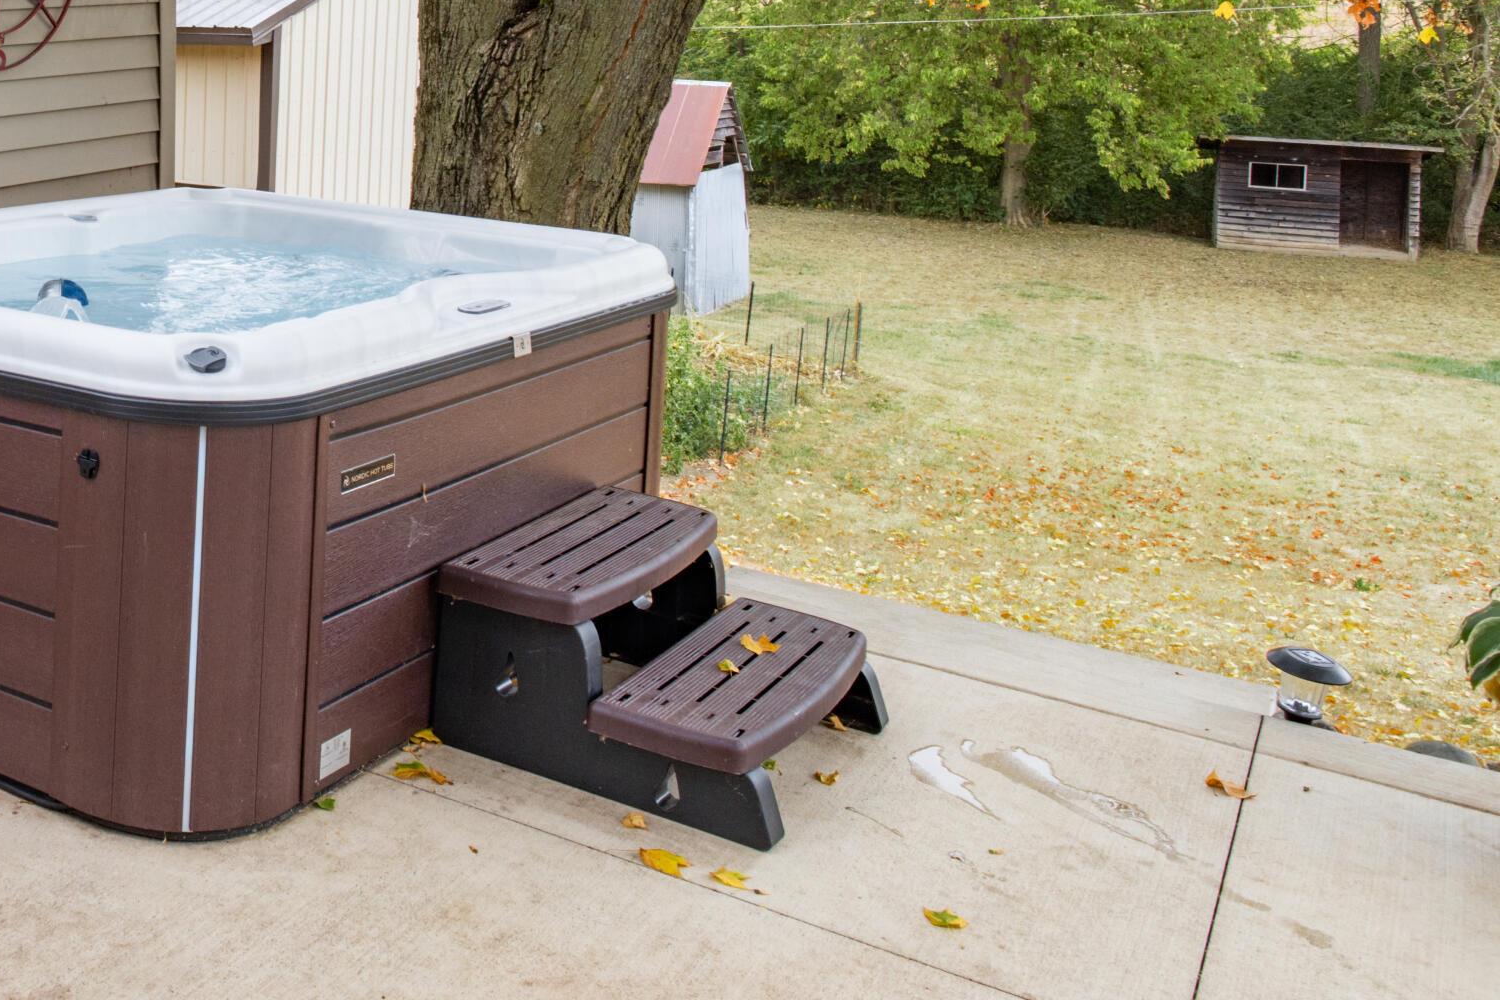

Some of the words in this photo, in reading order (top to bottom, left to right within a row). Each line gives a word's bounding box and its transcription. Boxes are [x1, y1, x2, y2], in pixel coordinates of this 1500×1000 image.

[351, 471, 370, 482] NORDIC
[370, 466, 380, 475] HOT
[381, 462, 394, 472] TUBS
